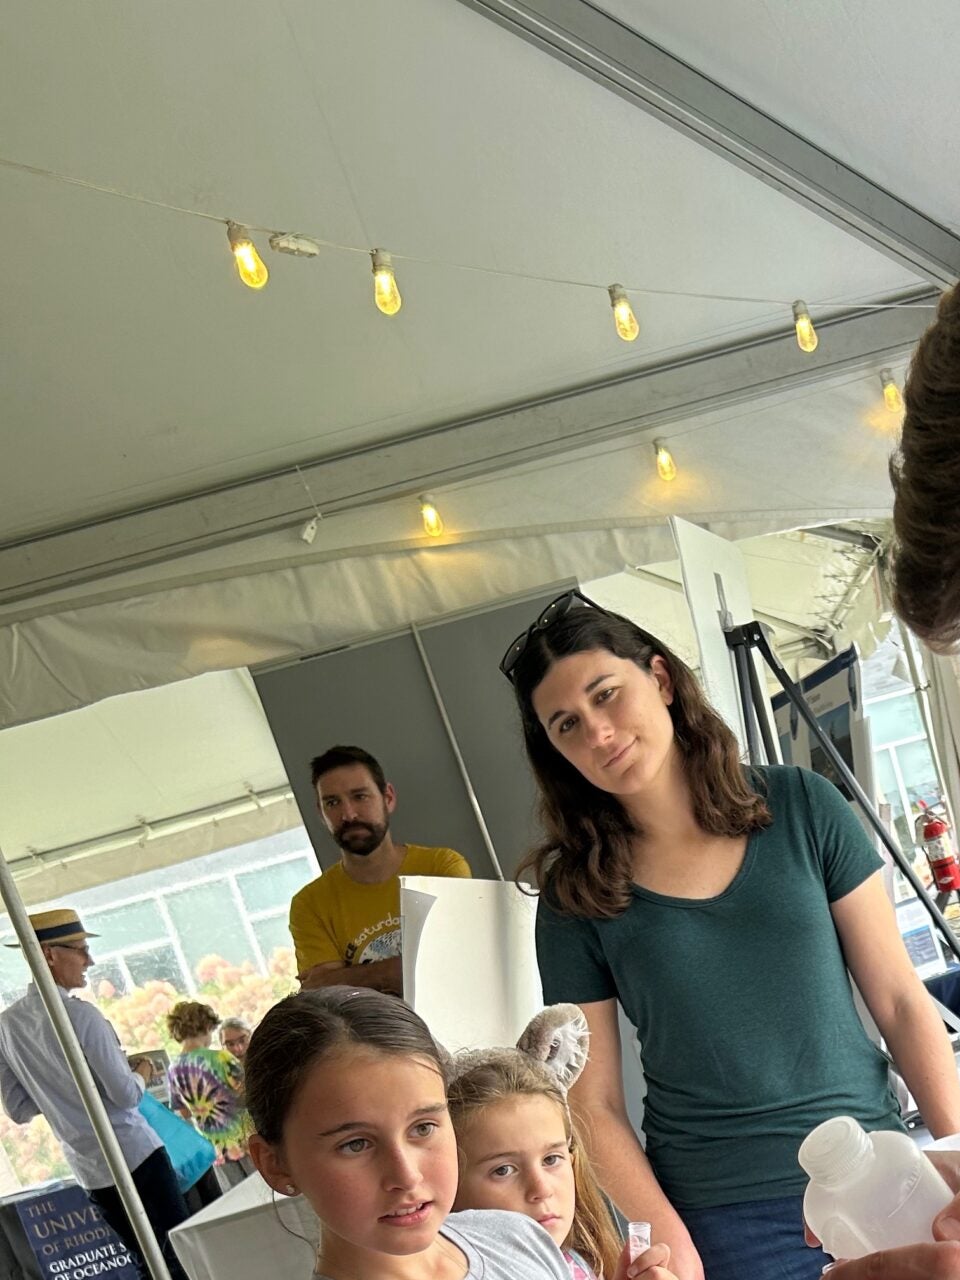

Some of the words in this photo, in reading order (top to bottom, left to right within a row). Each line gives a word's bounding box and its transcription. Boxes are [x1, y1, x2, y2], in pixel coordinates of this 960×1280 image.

[26, 1201, 56, 1218] THE
[42, 1243, 59, 1256] OF
[49, 1243, 117, 1273] GRADUATE
